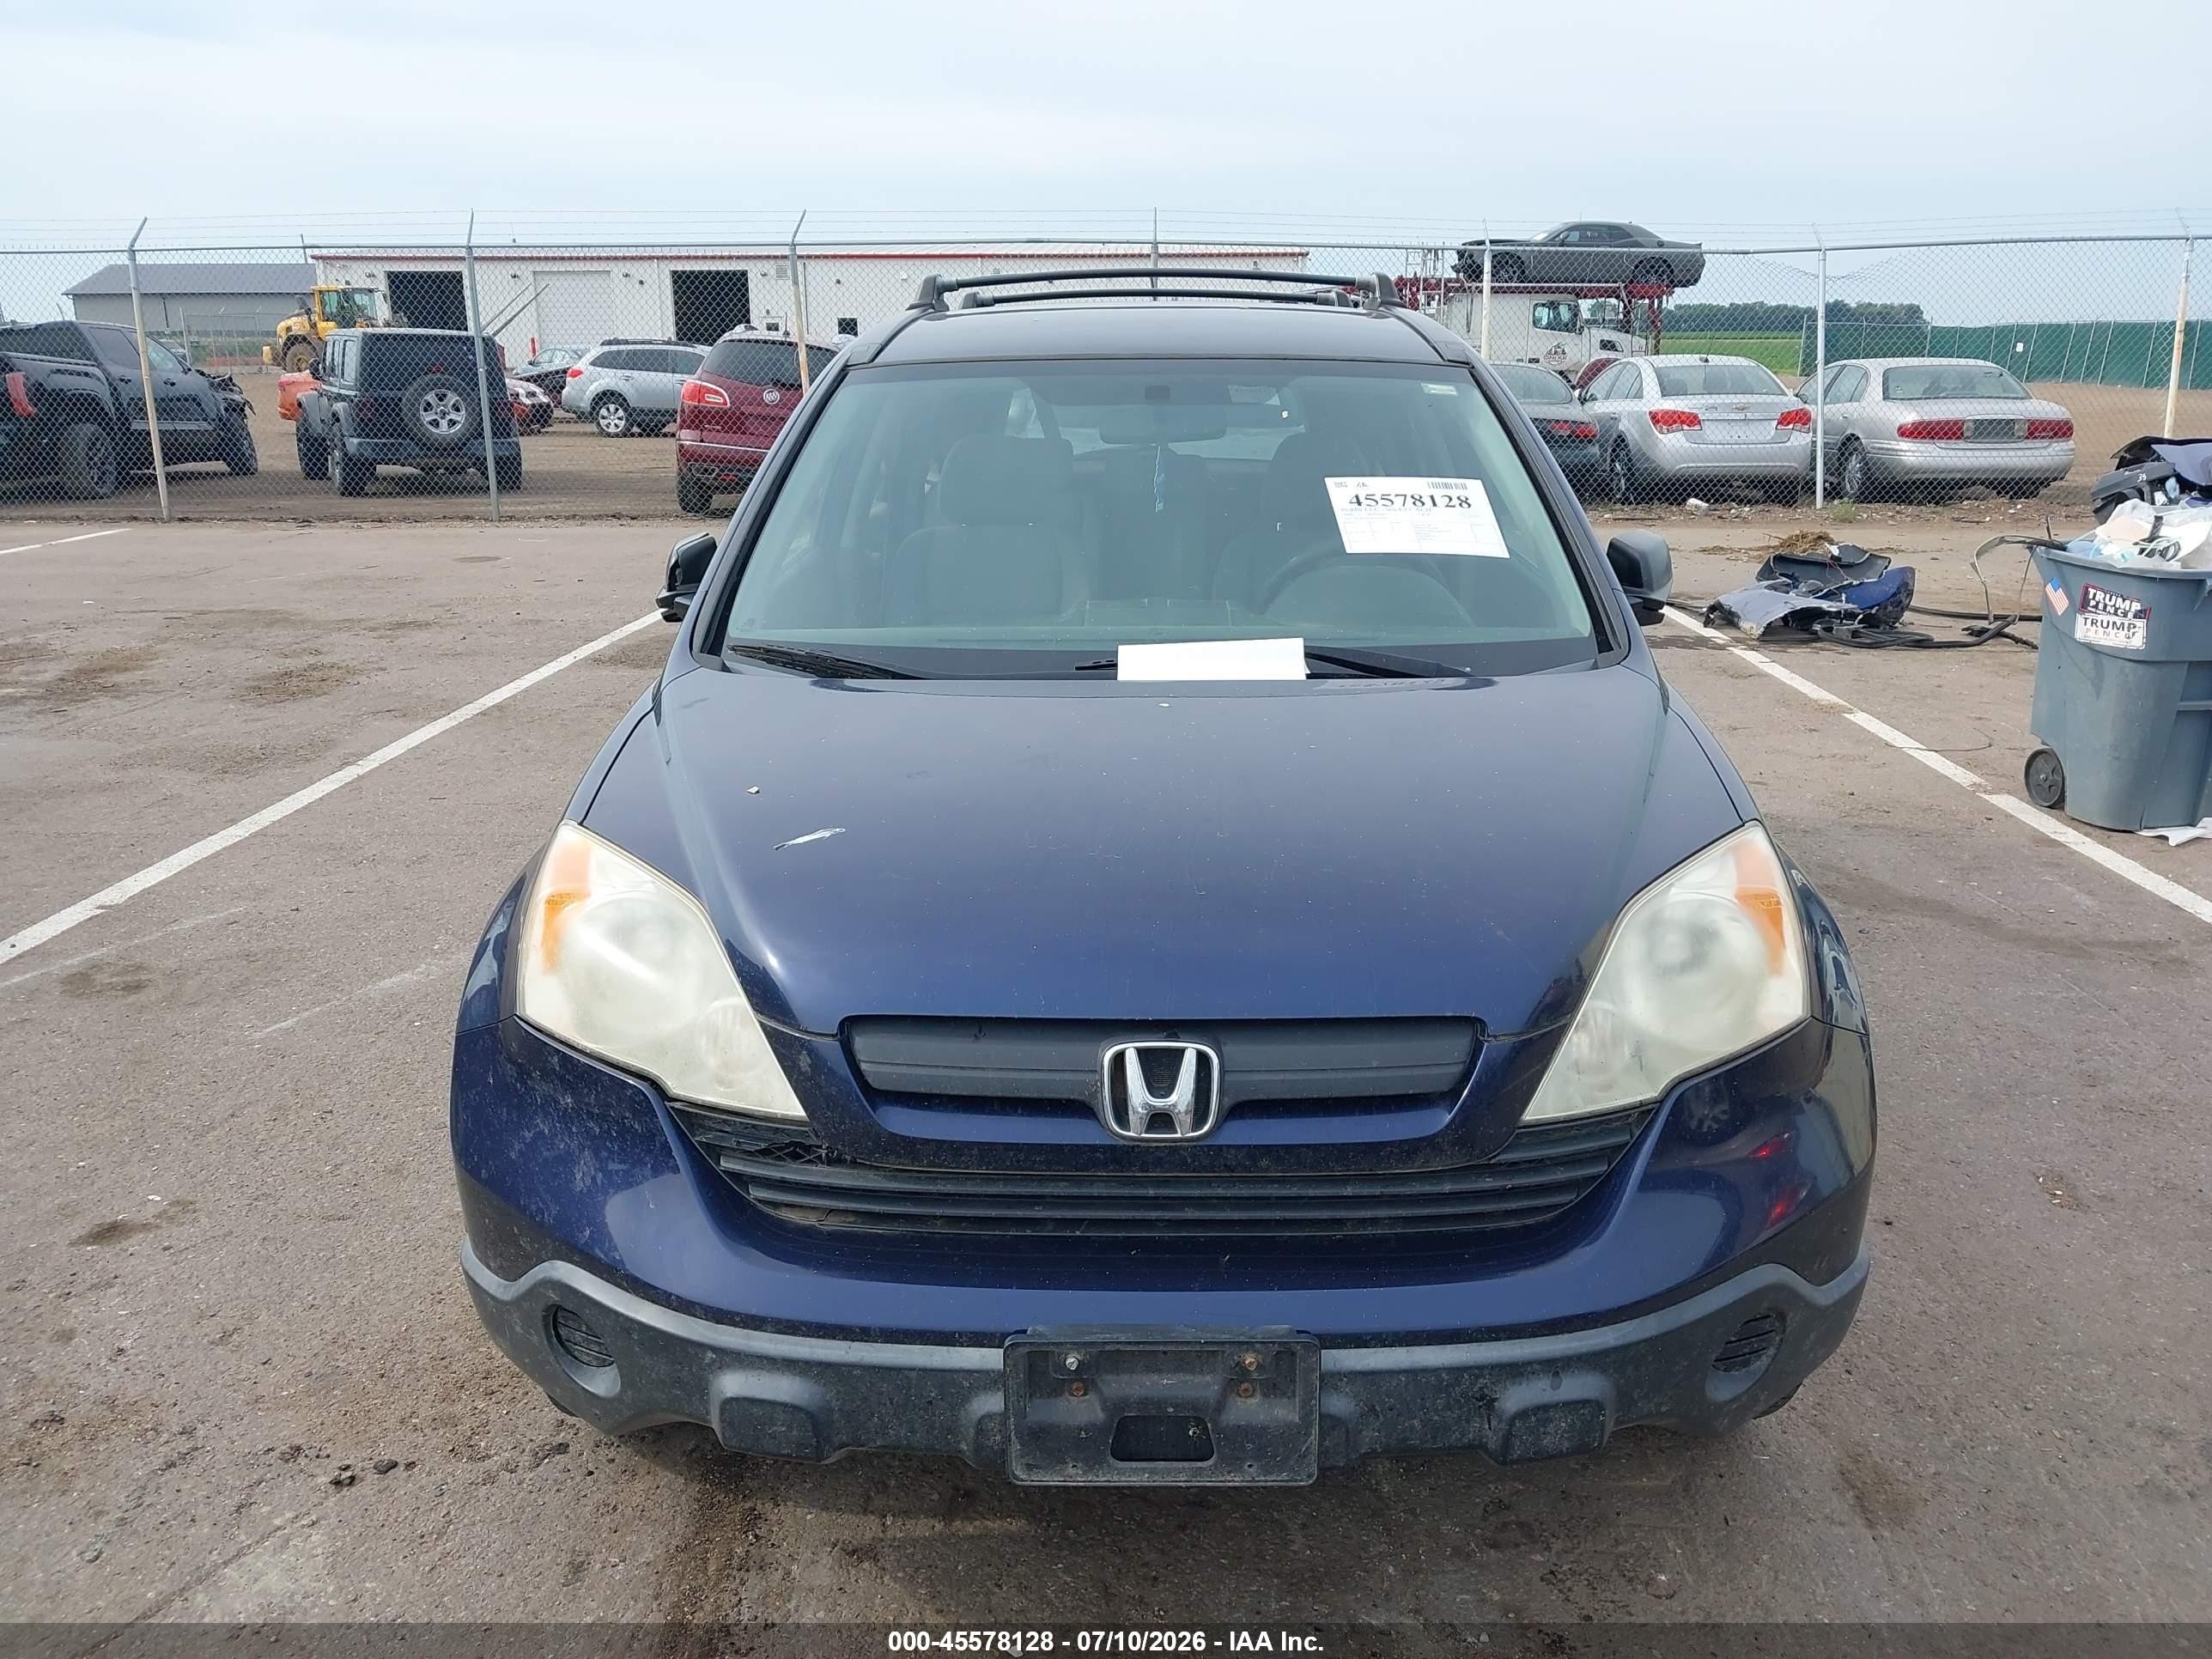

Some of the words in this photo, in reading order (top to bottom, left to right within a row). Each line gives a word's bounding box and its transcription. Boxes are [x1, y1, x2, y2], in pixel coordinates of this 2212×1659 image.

[1349, 494, 1472, 508] 45578128
[2087, 587, 2142, 611] TRUMP
[2082, 617, 2137, 632] TRUMP
